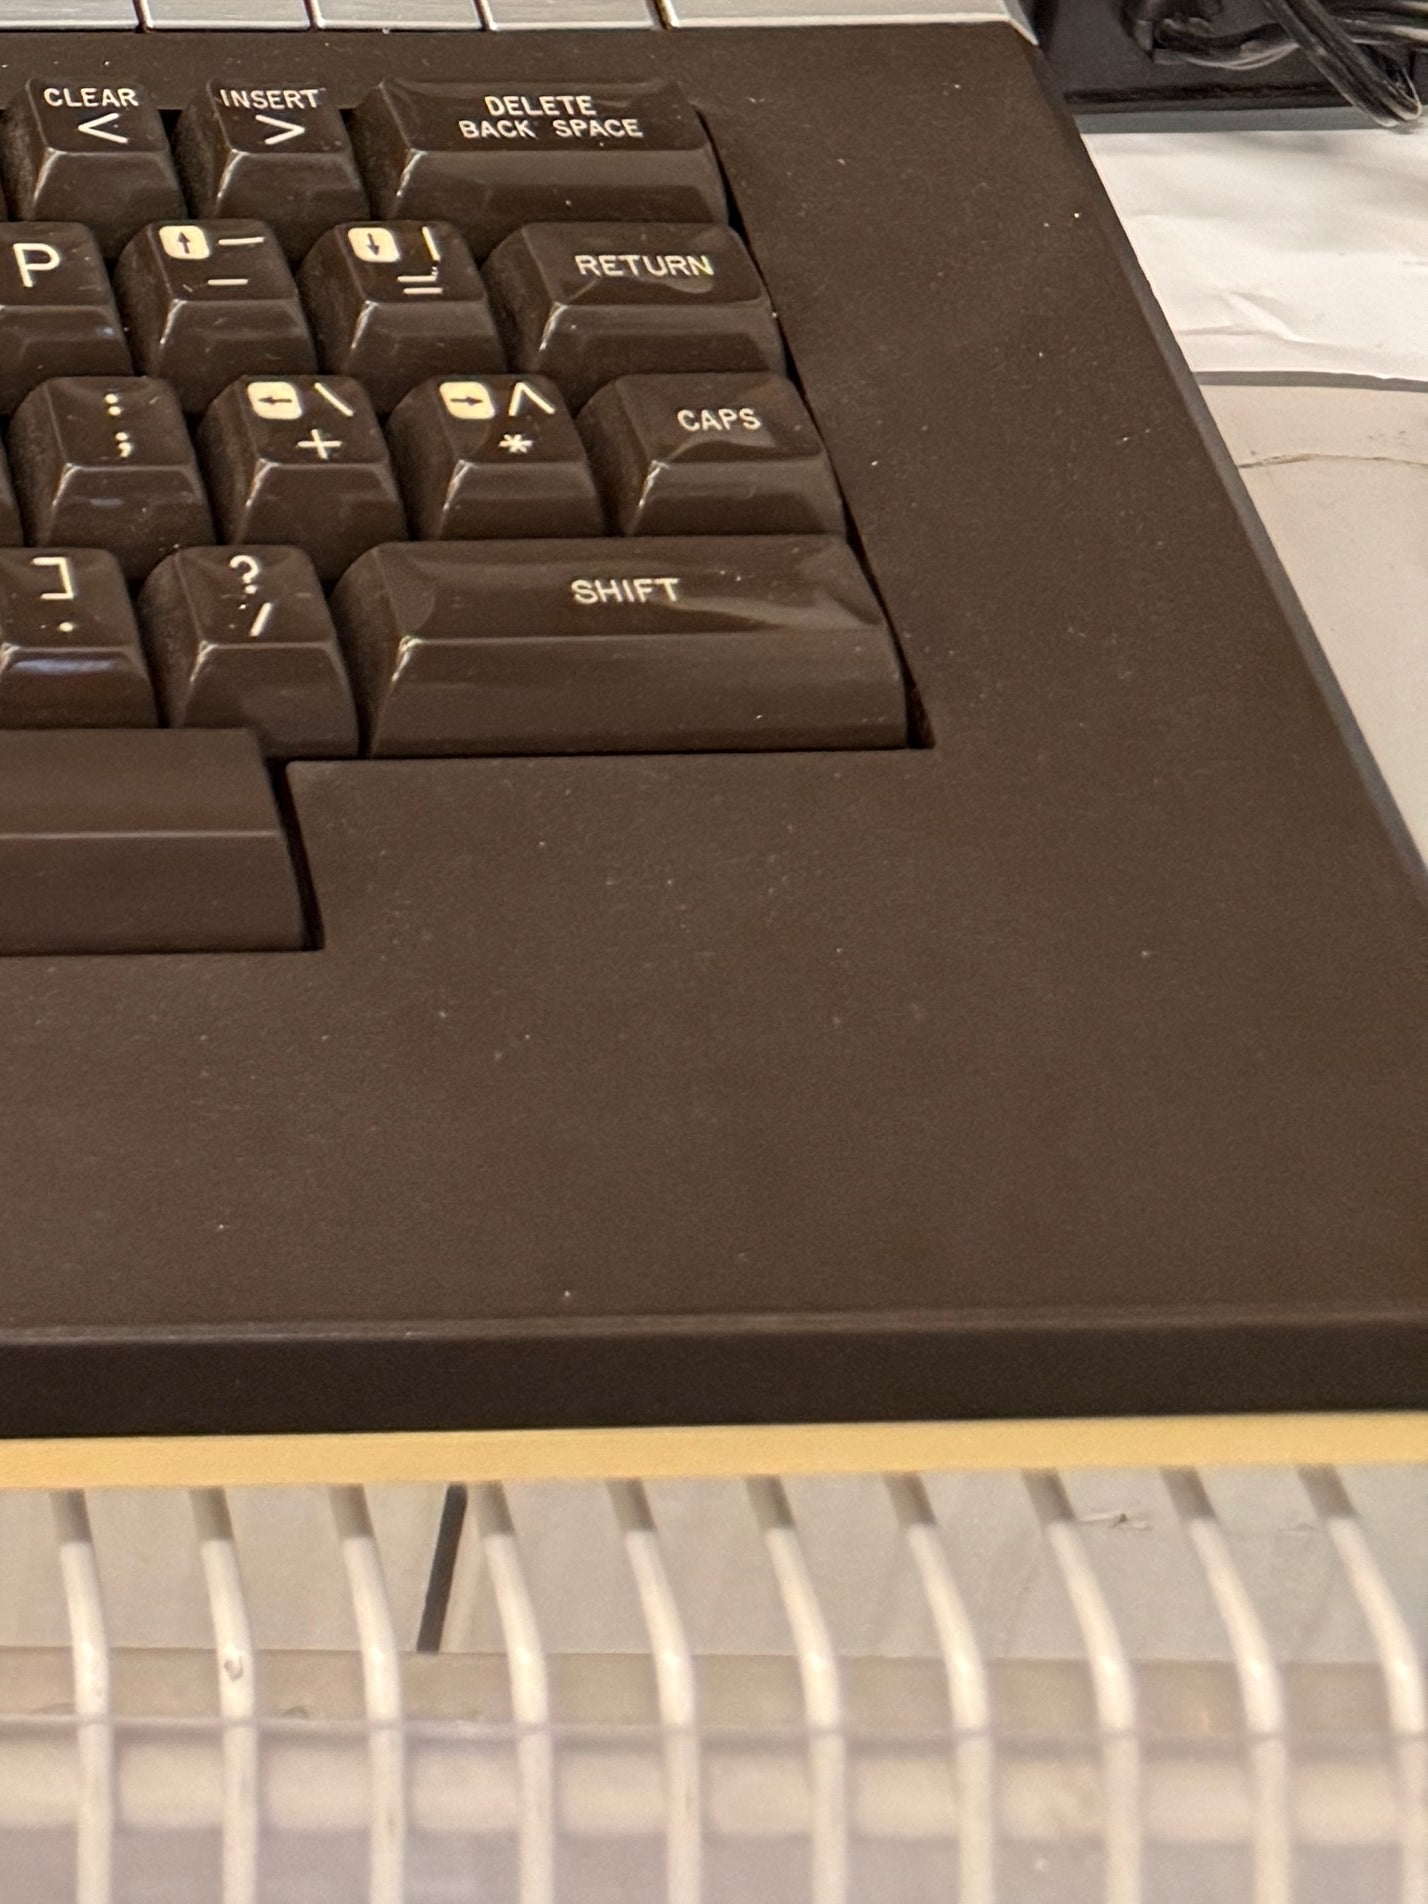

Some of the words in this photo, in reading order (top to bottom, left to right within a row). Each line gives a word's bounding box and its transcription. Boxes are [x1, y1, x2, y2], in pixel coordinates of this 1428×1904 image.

[44, 88, 138, 107] CLEAR
[220, 89, 320, 109] INSERT
[484, 96, 596, 117] DELETE
[458, 120, 535, 139] BACK
[554, 119, 643, 138] SPACE
[13, 243, 60, 287] P
[574, 254, 714, 278] RETURN
[677, 408, 763, 432] CAPS
[570, 578, 680, 604] SHIFT
